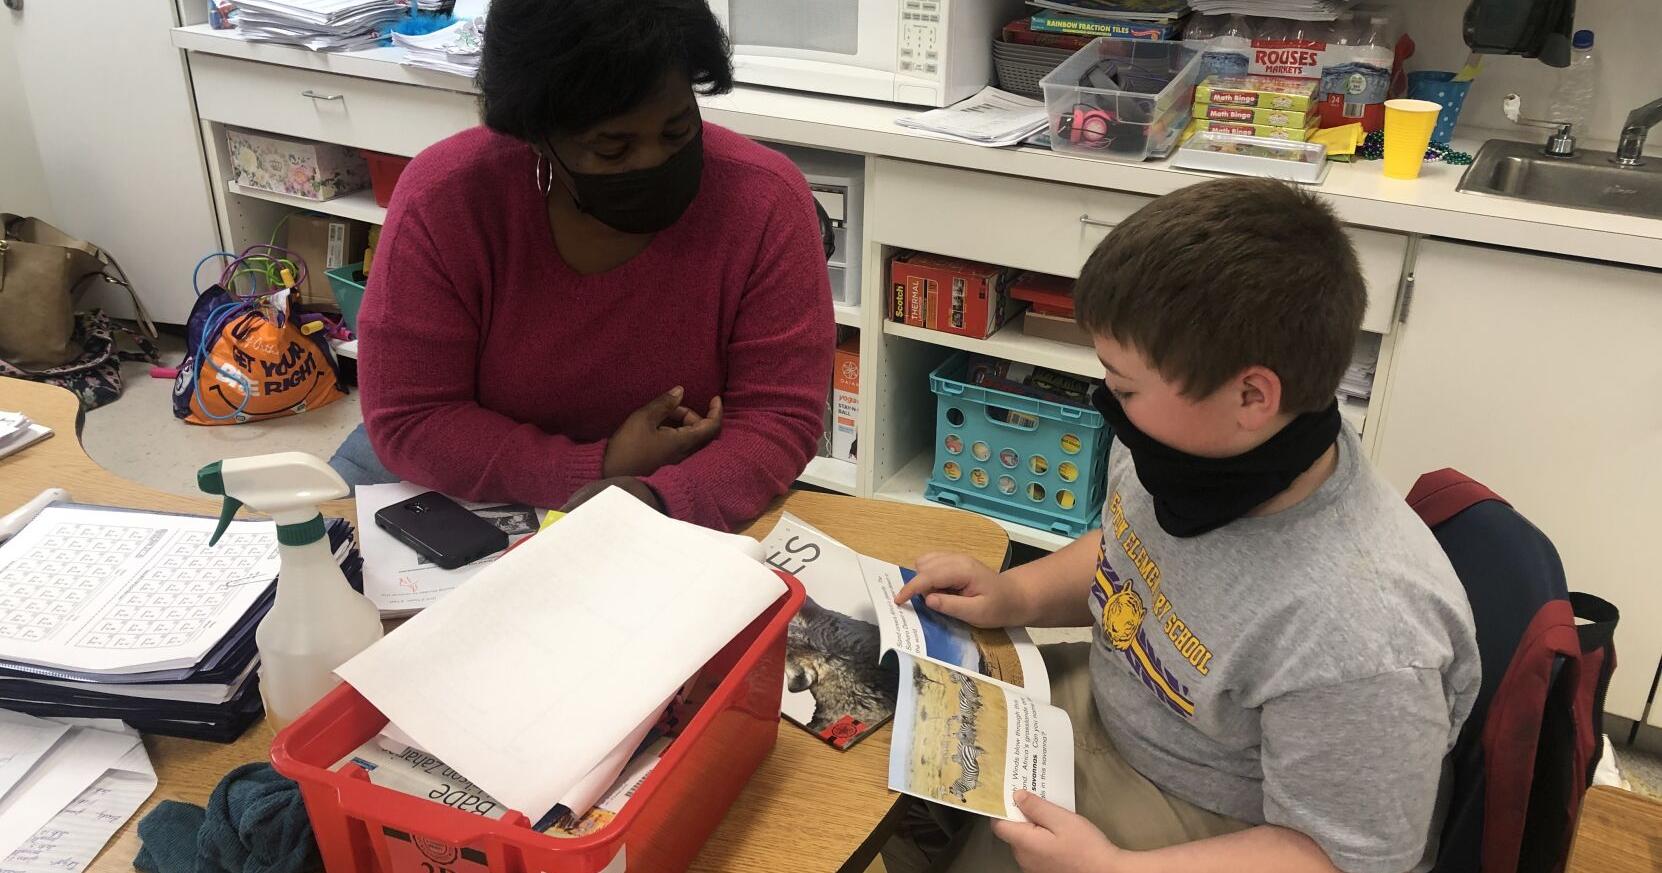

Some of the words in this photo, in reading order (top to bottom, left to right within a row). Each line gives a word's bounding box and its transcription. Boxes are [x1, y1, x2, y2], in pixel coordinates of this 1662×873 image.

[1046, 20, 1078, 29] RAINBOW
[1079, 23, 1111, 32] FRACTION
[1112, 26, 1130, 34] TILES
[1255, 50, 1318, 67] ROUSES
[1265, 65, 1303, 75] MARKETS
[1213, 94, 1233, 102] Math
[1234, 94, 1256, 104] Bingo
[1210, 110, 1230, 118] Math
[1230, 111, 1252, 120] Bingo
[1212, 127, 1231, 135] Math
[895, 284, 904, 318] Scotch
[911, 280, 919, 320] THERMAL
[259, 341, 306, 378] YOUR
[264, 351, 317, 396] RIGHT
[1164, 612, 1214, 677] SCHOOL
[1012, 757, 1020, 780] Winds
[428, 783, 497, 816] Babe
